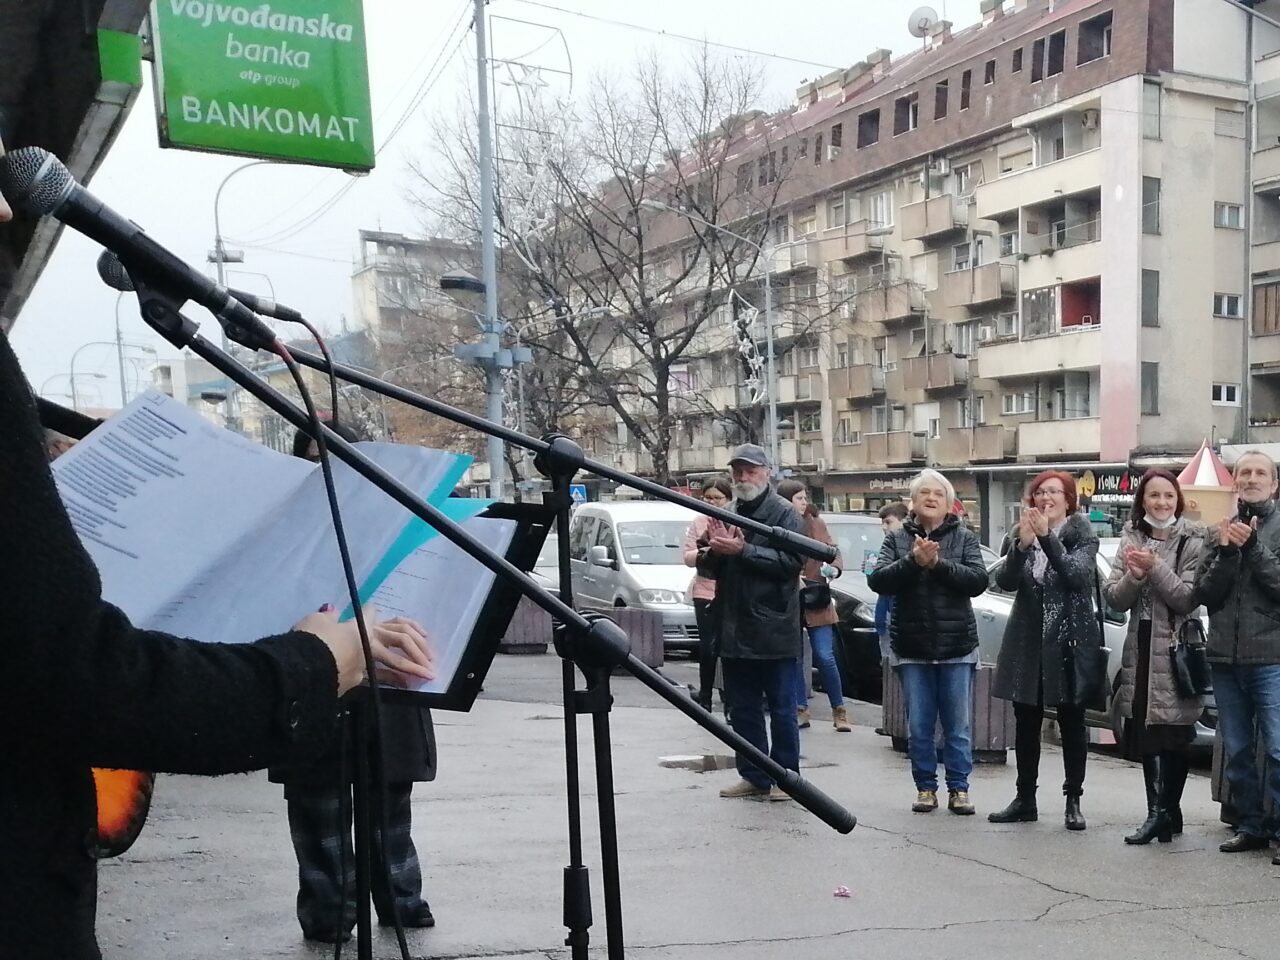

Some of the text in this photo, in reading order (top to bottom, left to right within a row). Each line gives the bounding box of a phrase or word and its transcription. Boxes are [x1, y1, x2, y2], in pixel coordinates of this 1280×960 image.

[225, 32, 310, 68] banka
[240, 70, 300, 88] otp group
[182, 96, 359, 142] BANKOMAT
